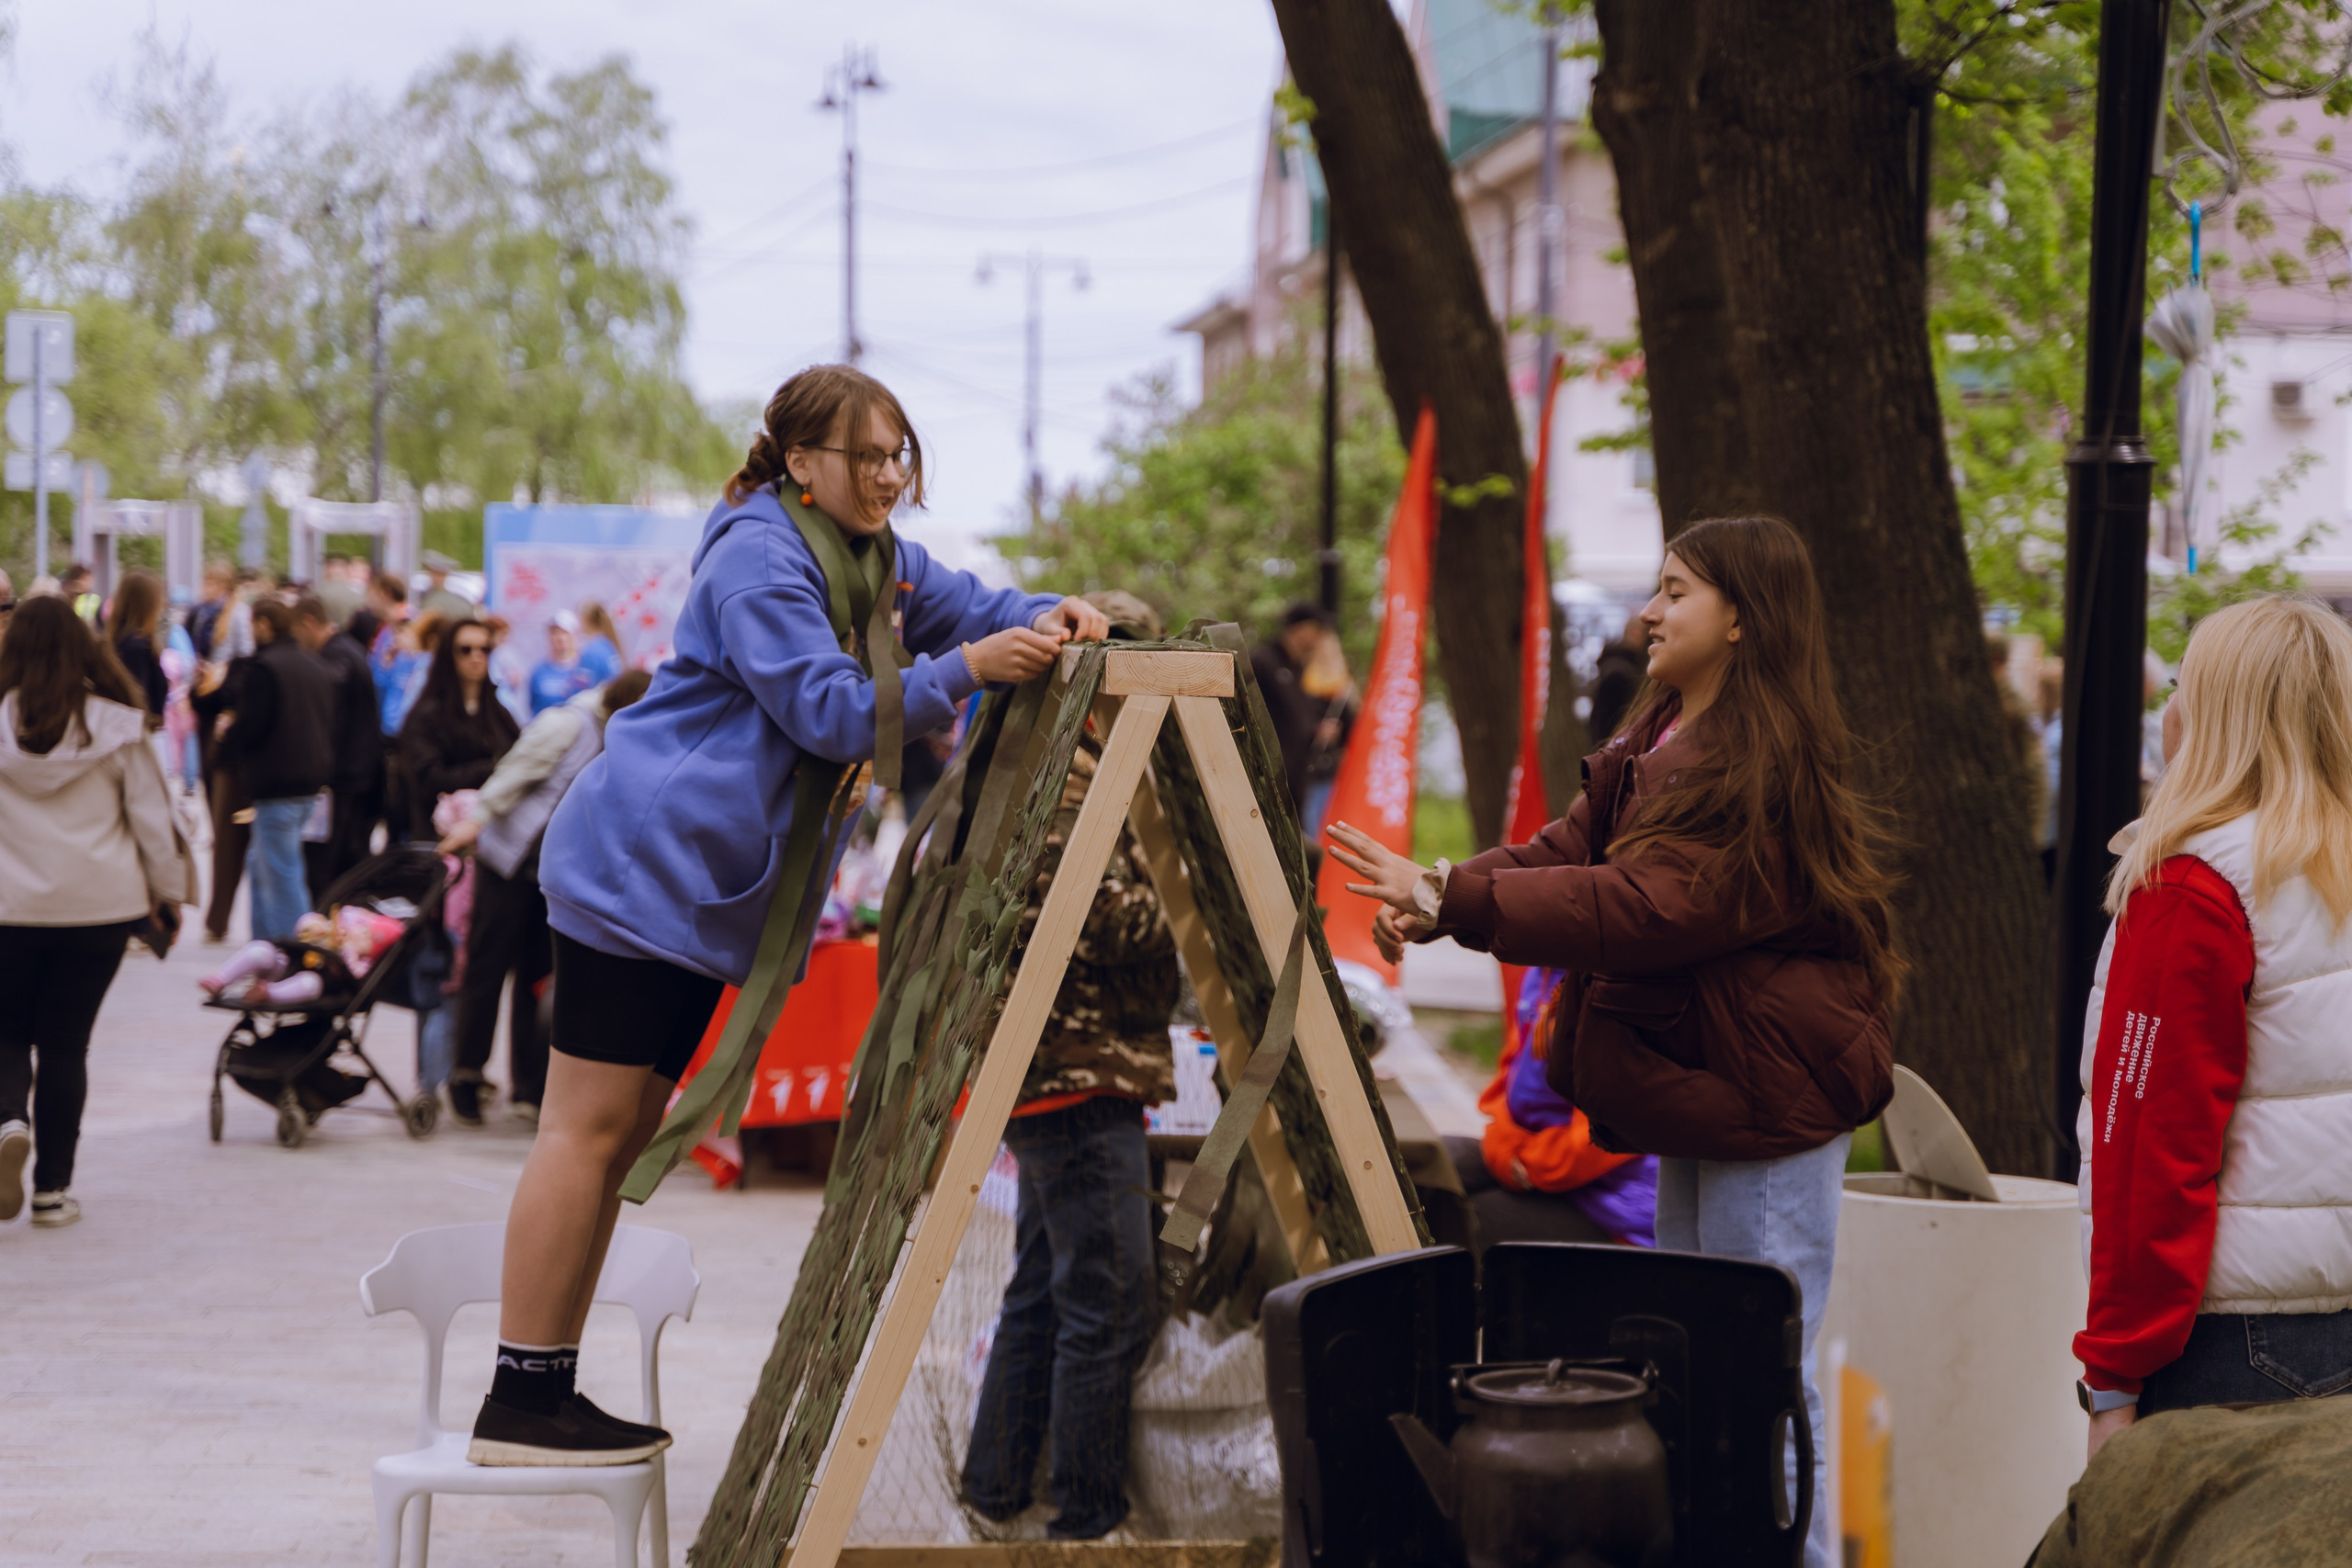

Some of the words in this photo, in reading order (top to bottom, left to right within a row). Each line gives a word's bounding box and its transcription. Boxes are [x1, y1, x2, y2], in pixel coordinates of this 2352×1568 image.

[2117, 1057, 2126, 1066] и
[2120, 1010, 2135, 1053] детей
[2125, 1013, 2148, 1083] движение
[2134, 1017, 2162, 1100] Российское
[2103, 1070, 2123, 1144] молодёжи
